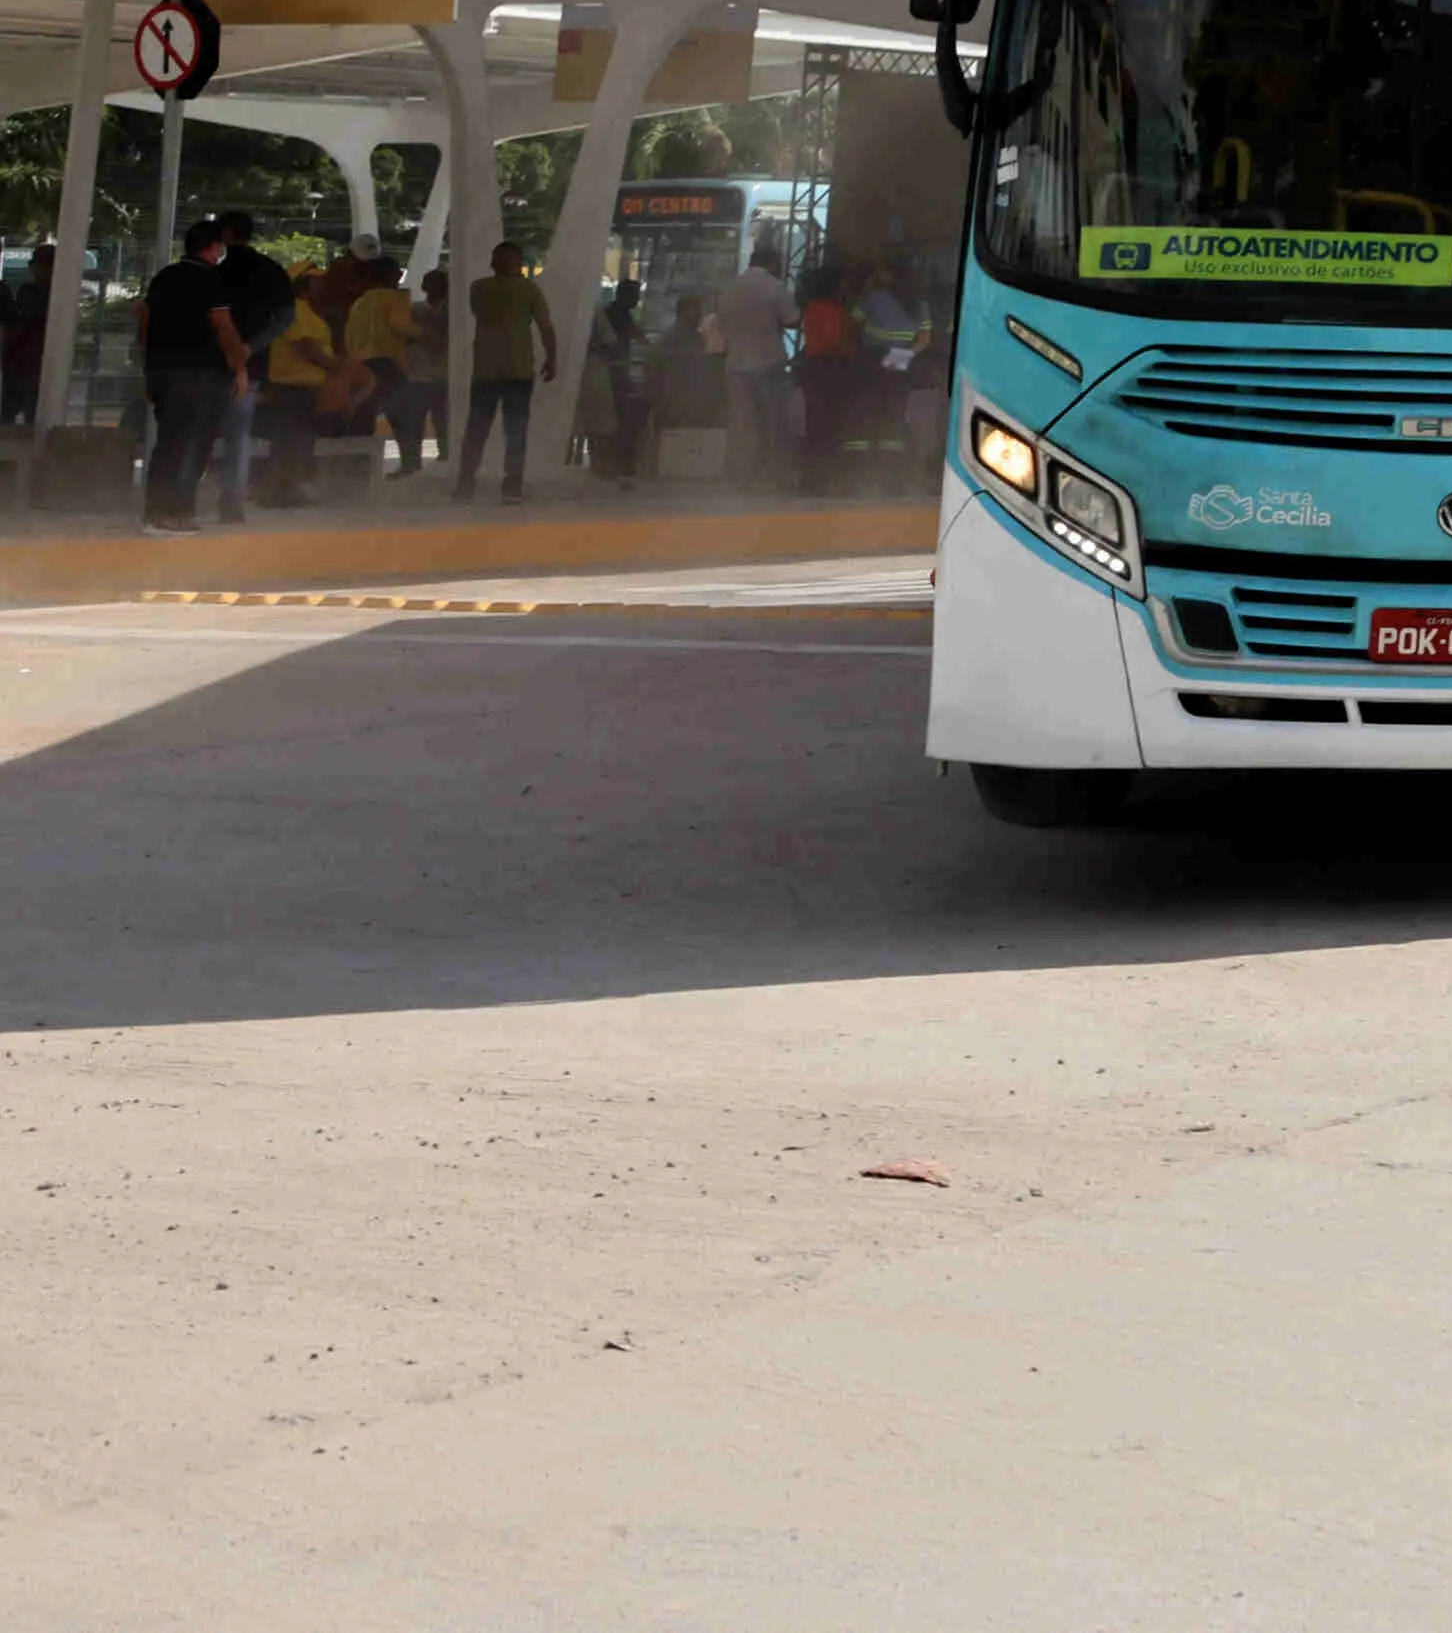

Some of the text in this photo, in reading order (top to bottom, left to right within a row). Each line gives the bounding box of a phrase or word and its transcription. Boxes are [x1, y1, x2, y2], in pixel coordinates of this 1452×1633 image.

[1184, 260, 1216, 274] Uso
[1221, 260, 1300, 277] exclusivo
[1305, 263, 1328, 279] de
[1258, 486, 1313, 505] Santa
